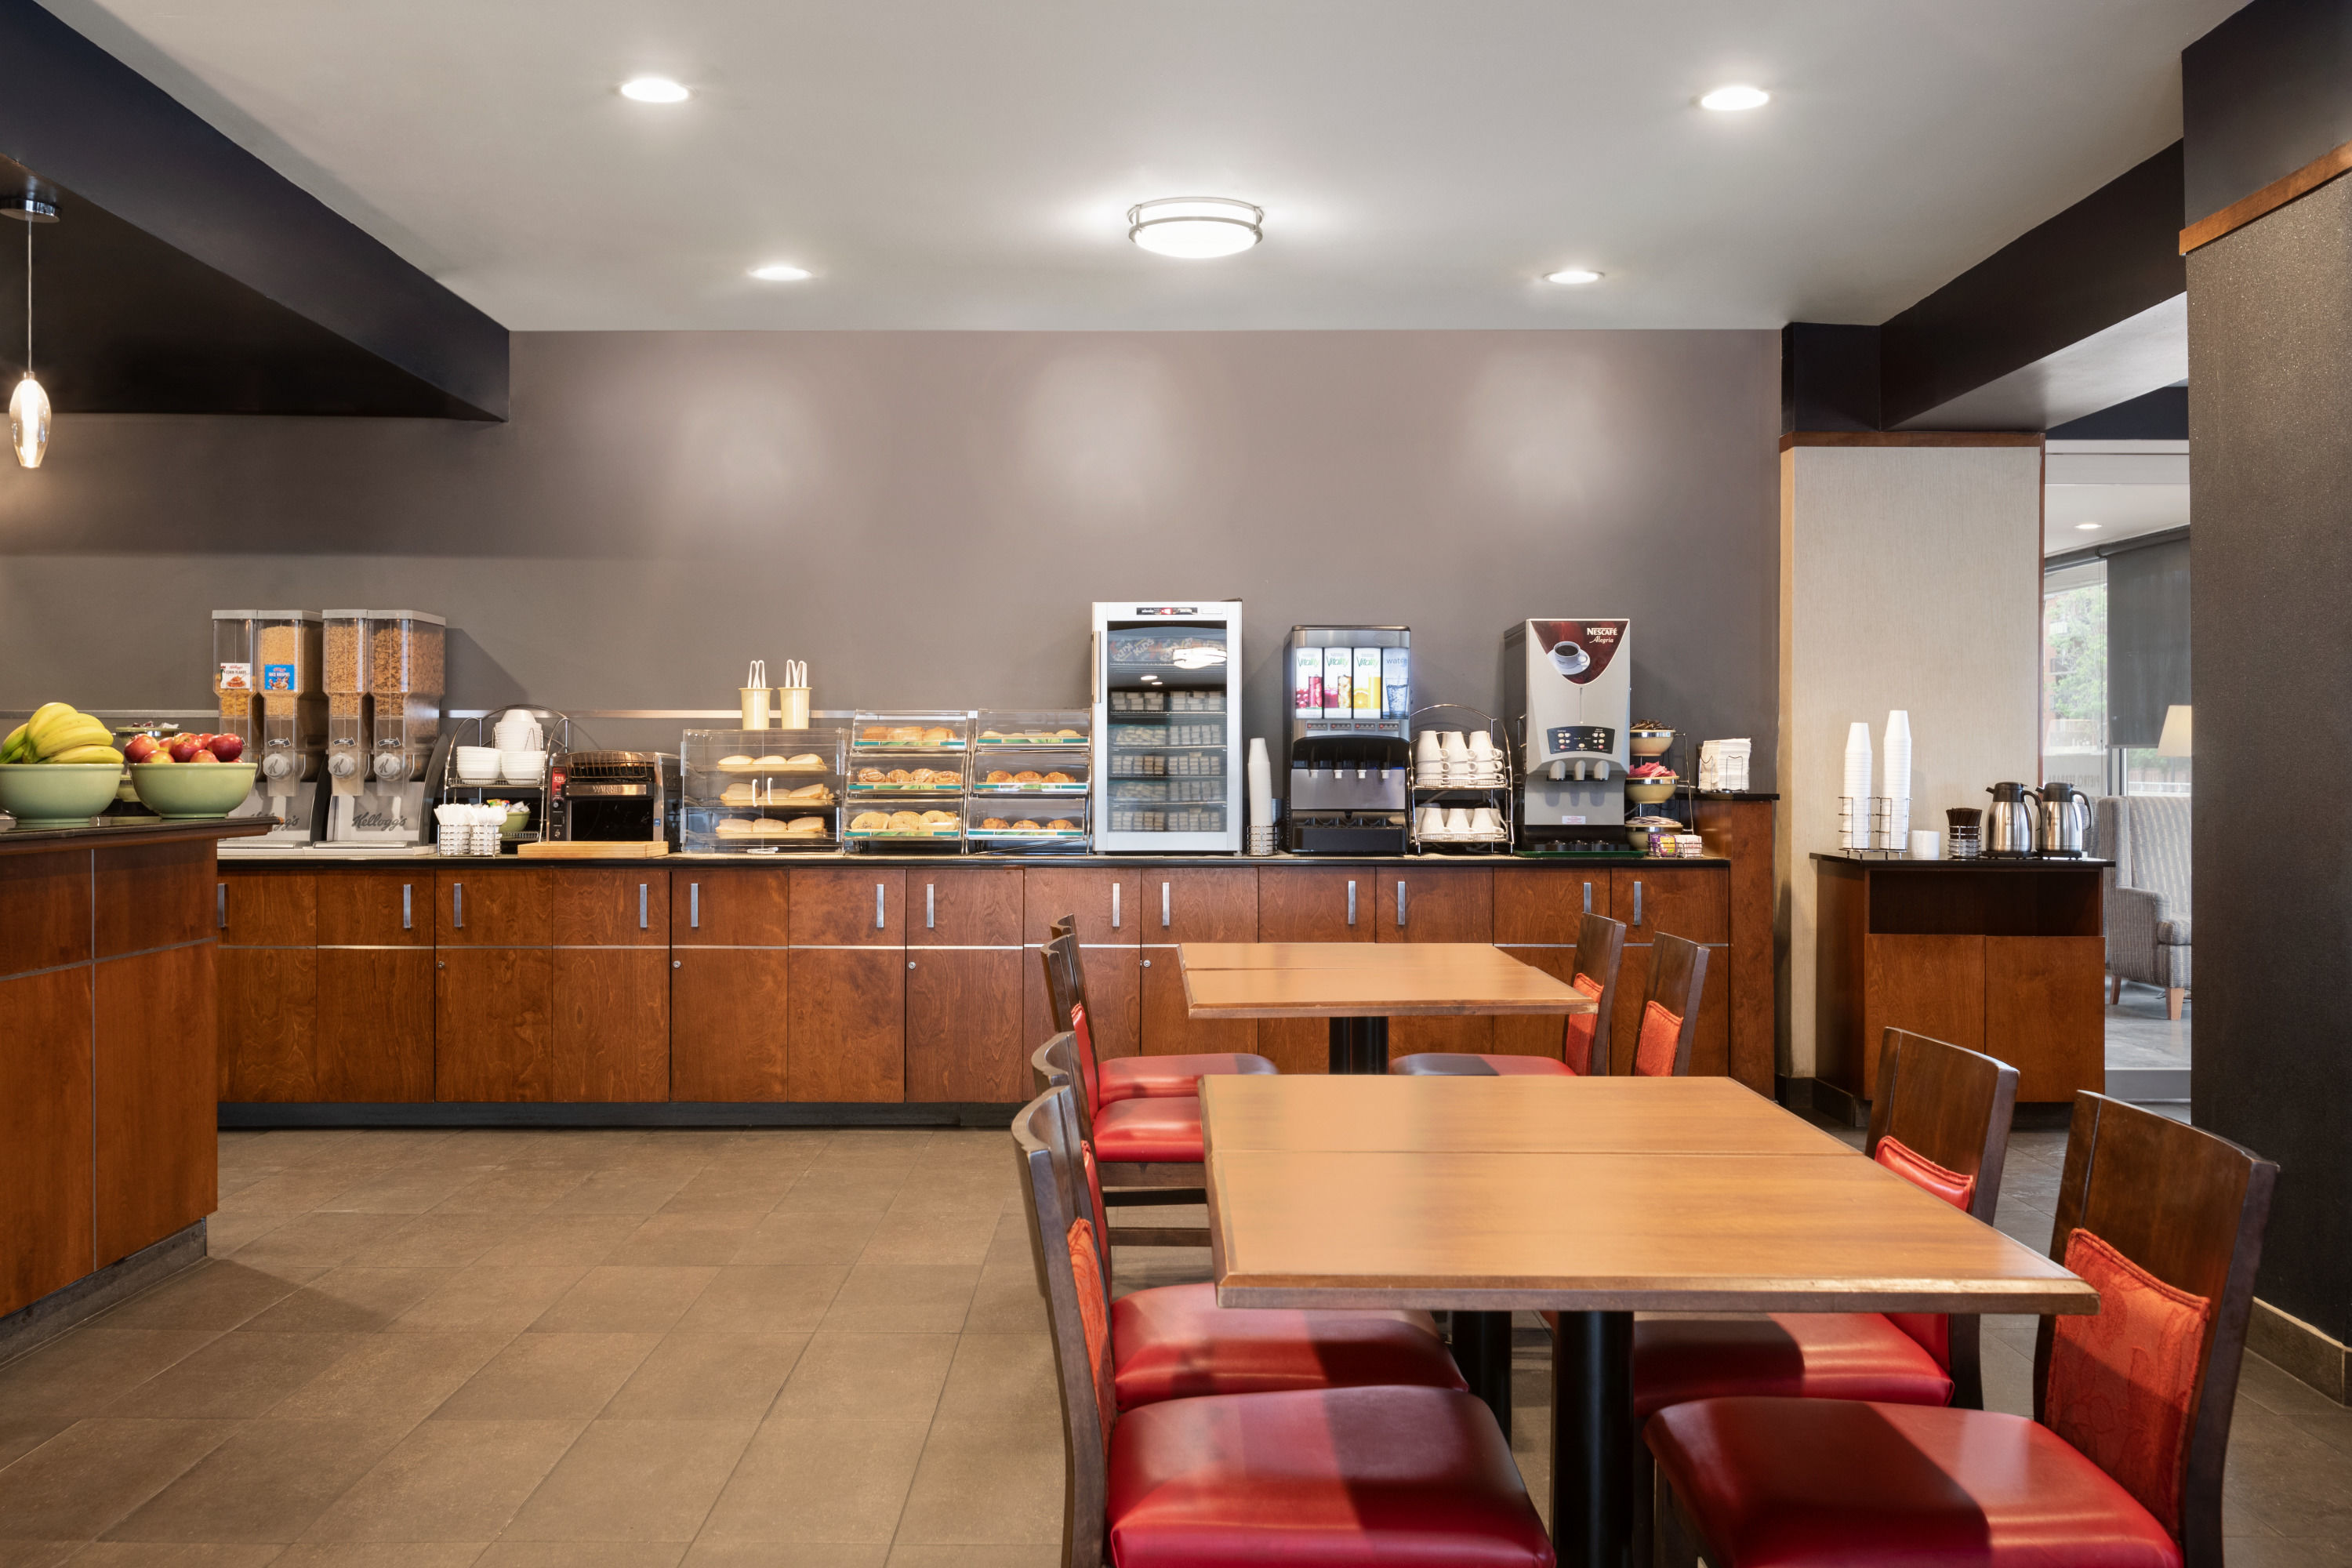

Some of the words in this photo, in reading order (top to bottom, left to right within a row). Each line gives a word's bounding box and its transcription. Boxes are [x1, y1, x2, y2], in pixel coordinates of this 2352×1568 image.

[1587, 627, 1617, 636] NESCAFÉ
[1589, 635, 1614, 644] Alegria
[1298, 655, 1320, 667] Vitality
[1326, 655, 1349, 667] Vitality
[1356, 655, 1378, 667] Vitality
[351, 811, 407, 831] Kellogg's
